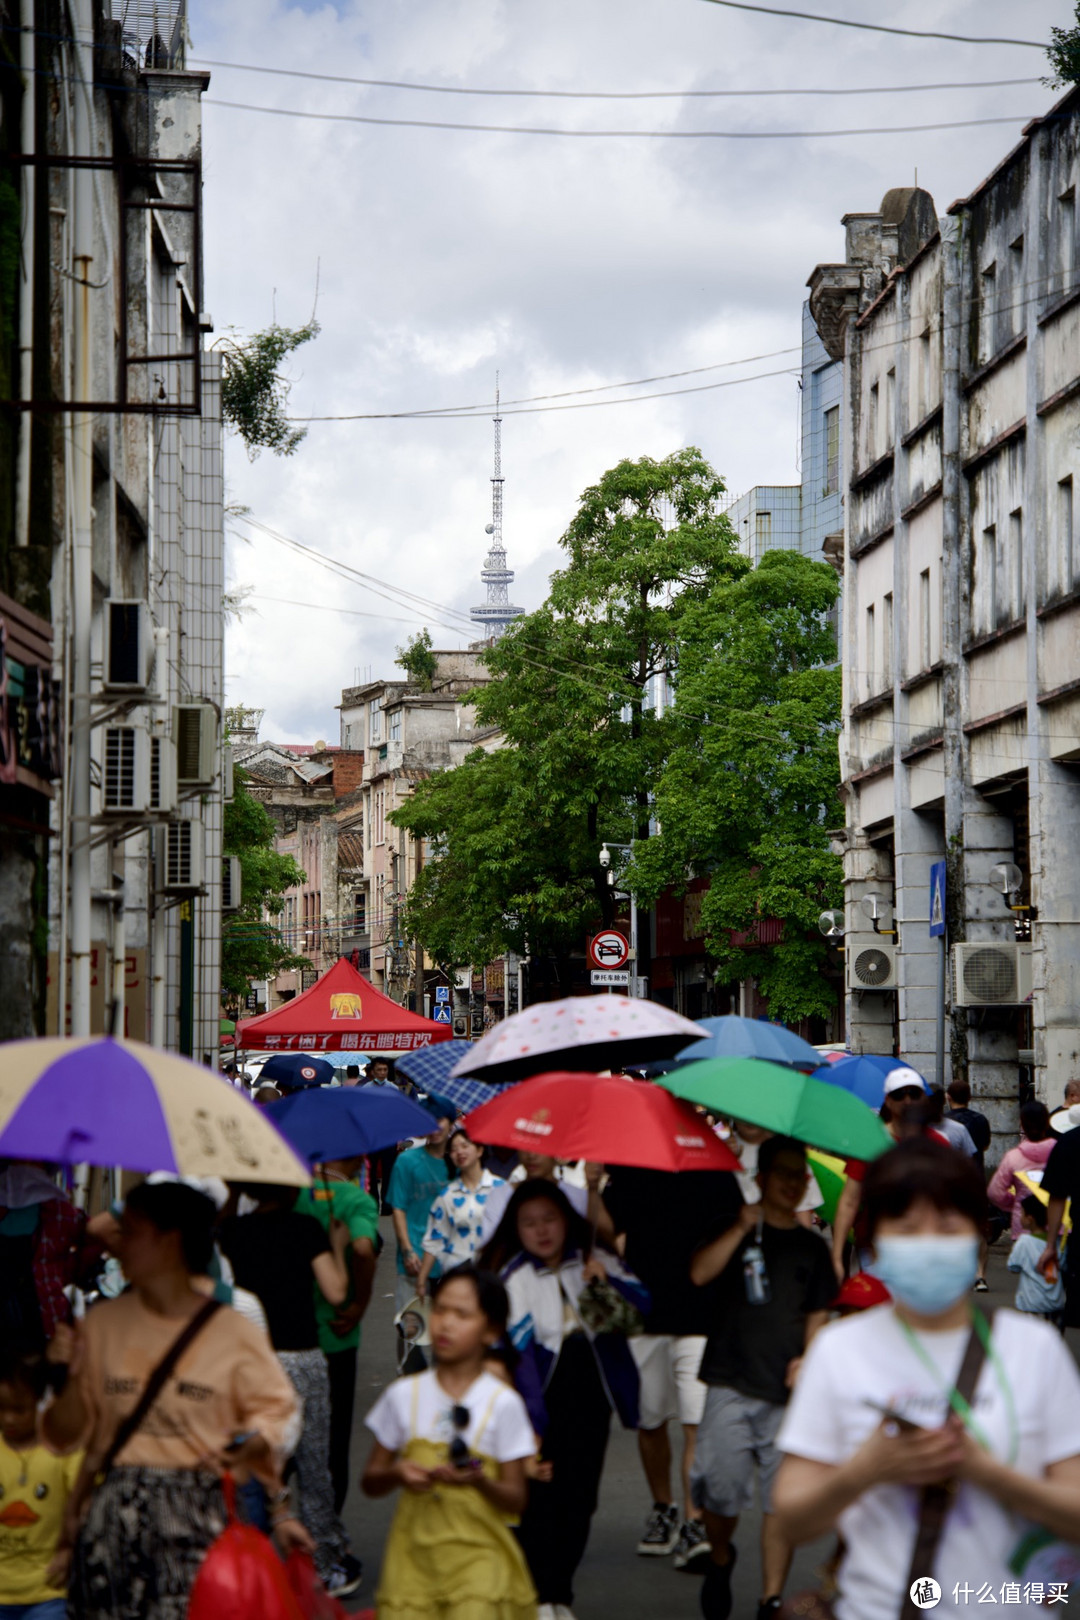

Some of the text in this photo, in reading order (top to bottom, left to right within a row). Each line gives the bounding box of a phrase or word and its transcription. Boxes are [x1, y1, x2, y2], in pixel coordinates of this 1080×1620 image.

[593, 974, 628, 982] 摩托车除外
[264, 1032, 432, 1049] 累了困了 喝东鹏特饮
